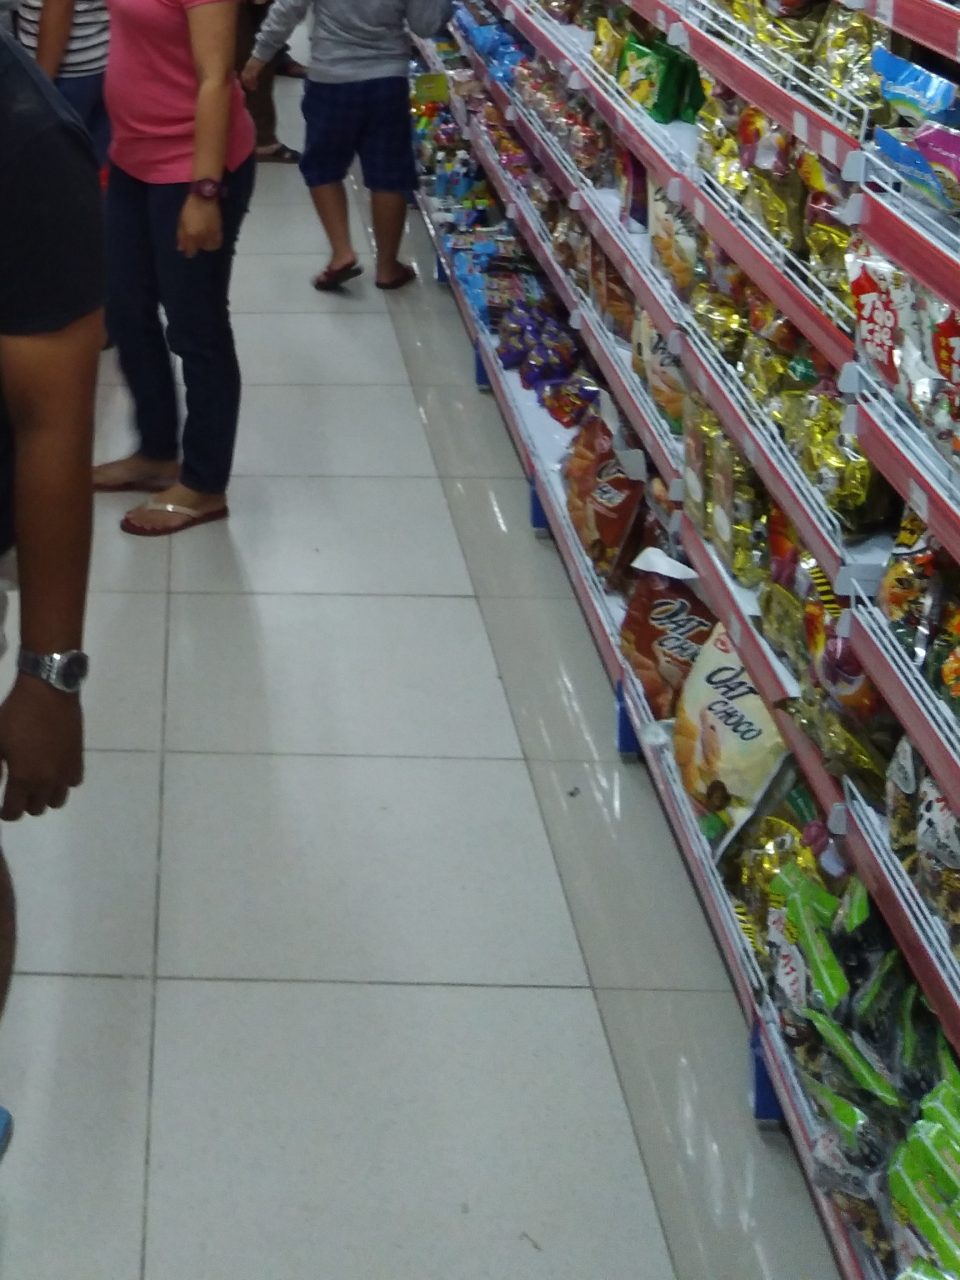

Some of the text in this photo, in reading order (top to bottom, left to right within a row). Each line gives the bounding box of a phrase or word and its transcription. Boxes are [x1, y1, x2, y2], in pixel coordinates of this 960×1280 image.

[649, 598, 711, 638] OAT
[705, 665, 760, 701] OAT
[707, 699, 762, 741] CHOCO
